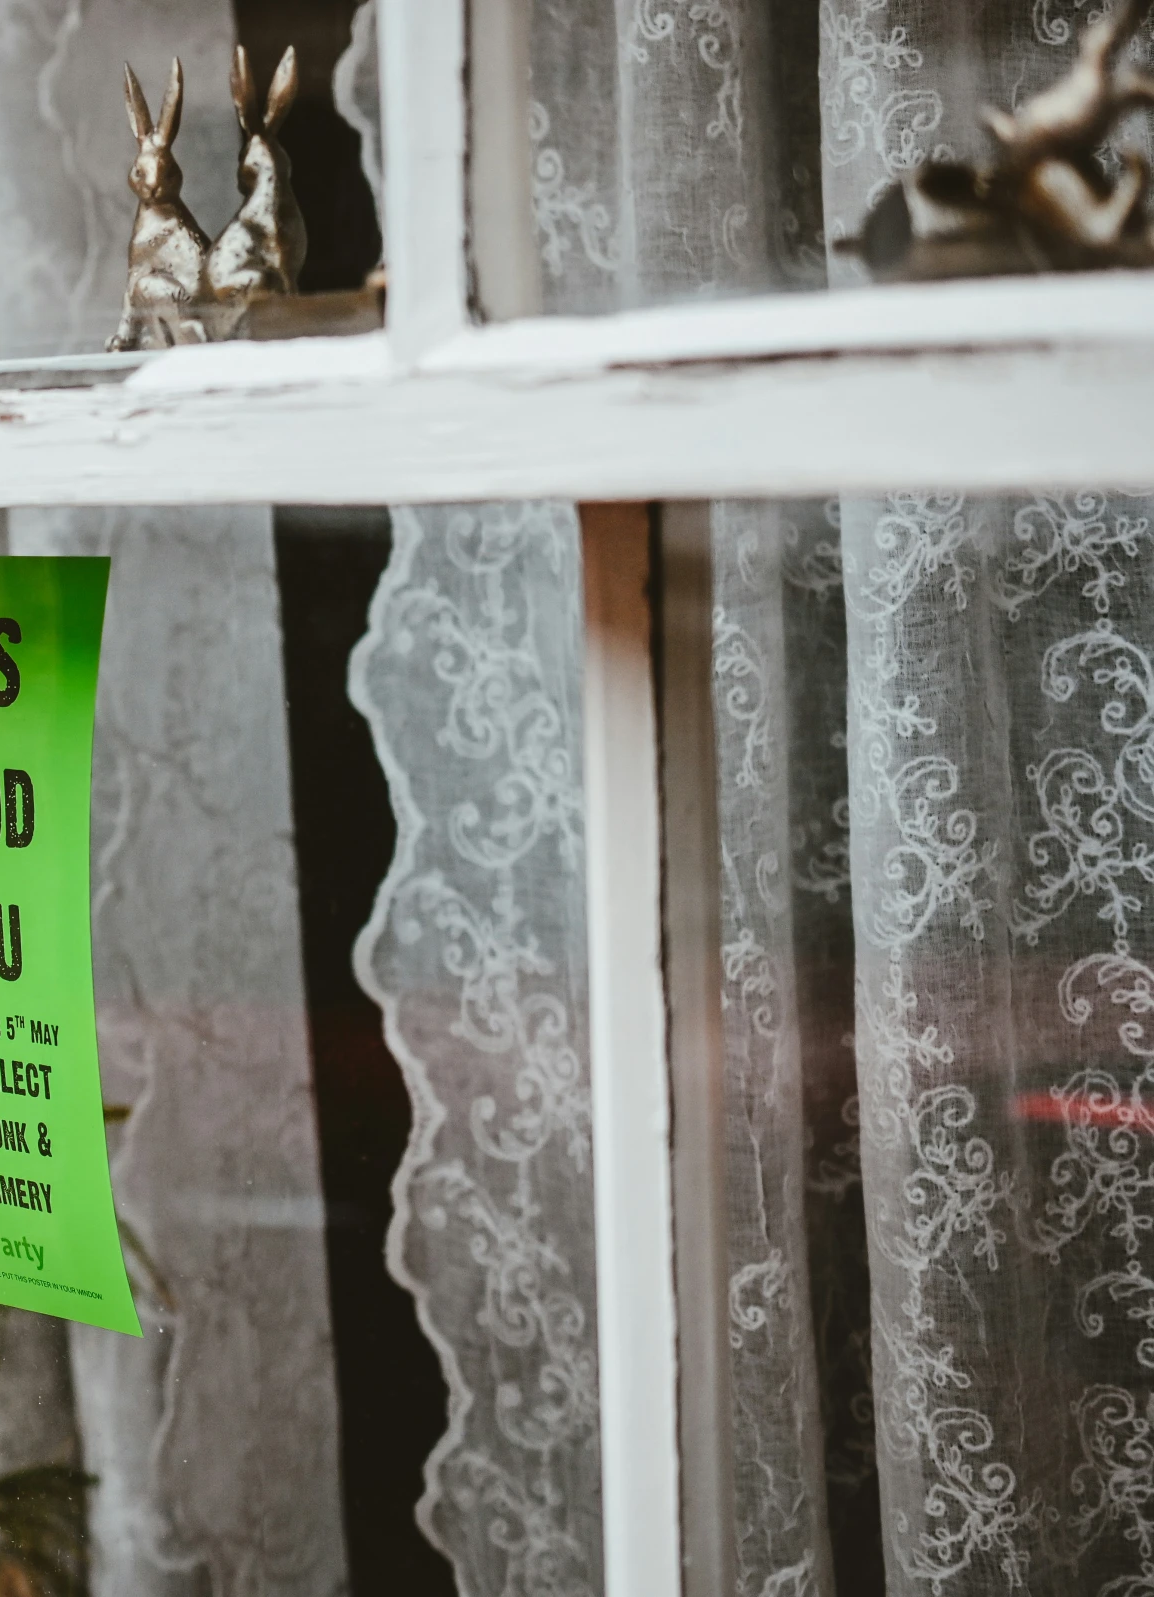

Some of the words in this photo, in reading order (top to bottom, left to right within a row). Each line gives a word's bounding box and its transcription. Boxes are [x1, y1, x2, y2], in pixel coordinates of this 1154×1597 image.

[38, 1122, 52, 1157] &
[2, 1271, 14, 1280] PUT
[15, 1274, 28, 1283] THIS
[28, 1277, 51, 1288] POSTER
[52, 1282, 59, 1290] IN
[59, 1284, 76, 1294] YOUR
